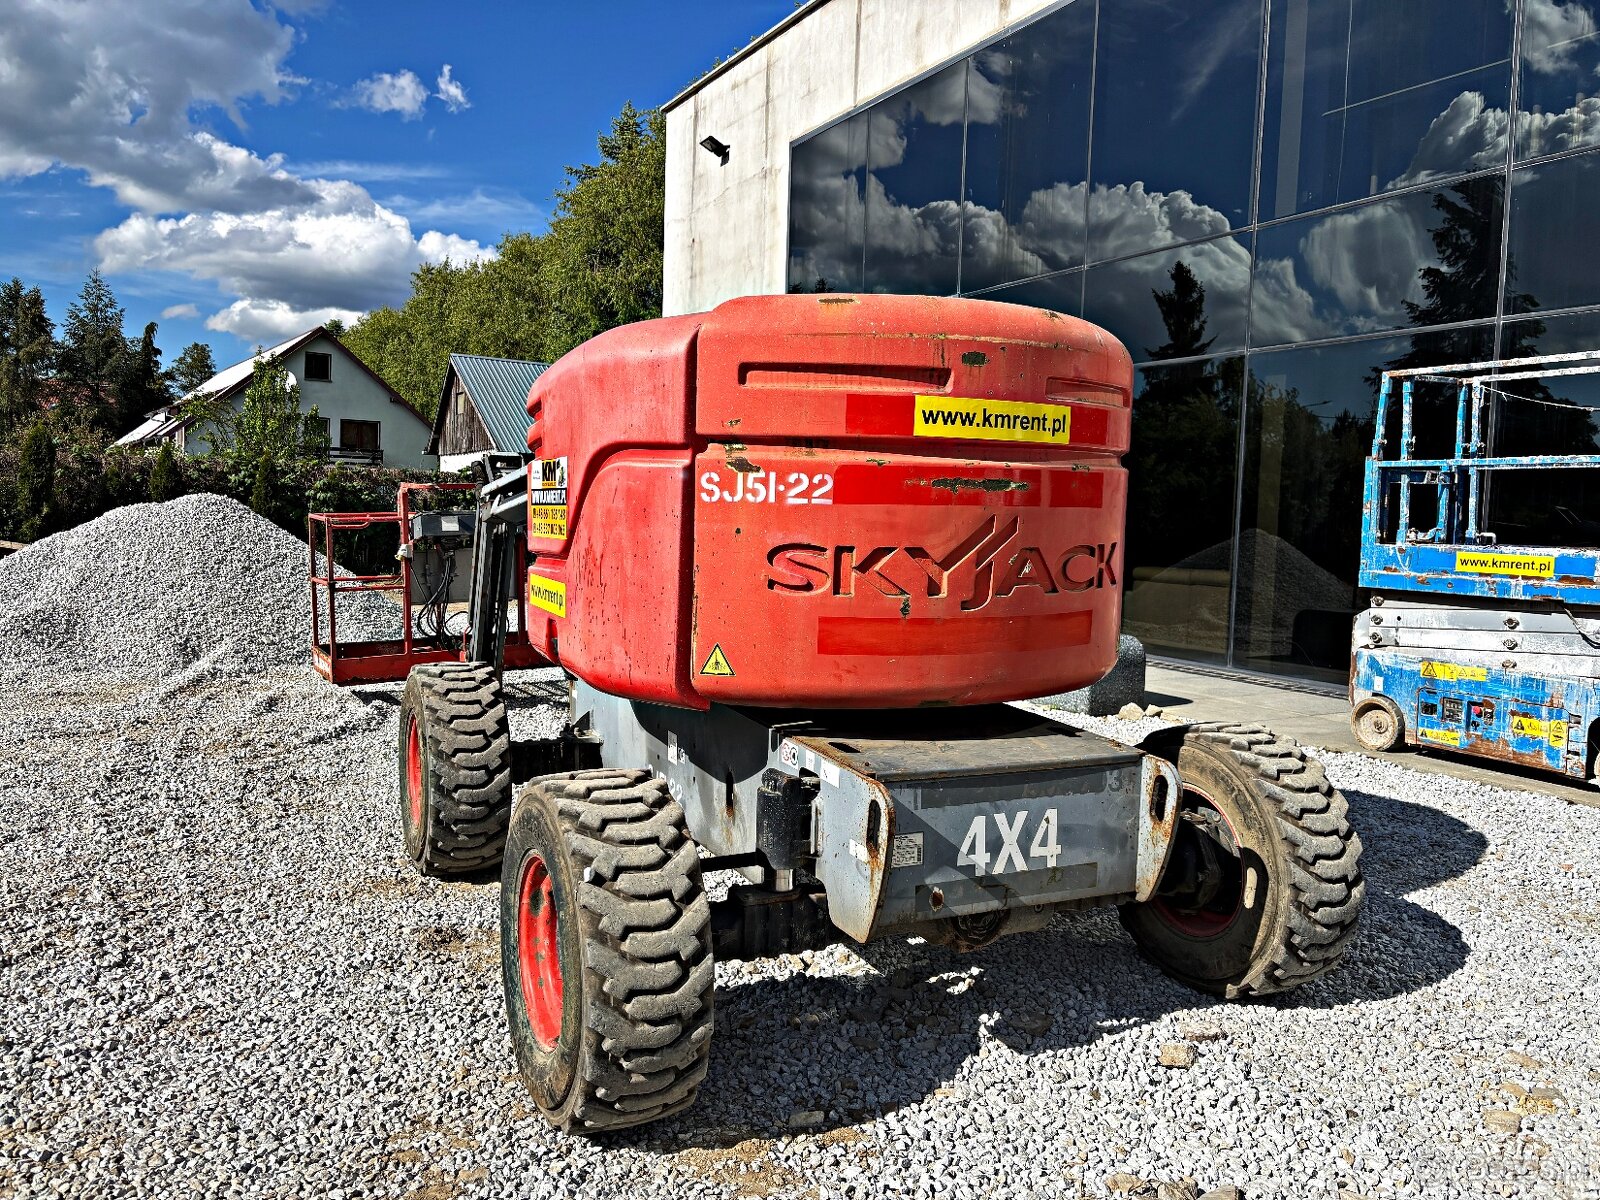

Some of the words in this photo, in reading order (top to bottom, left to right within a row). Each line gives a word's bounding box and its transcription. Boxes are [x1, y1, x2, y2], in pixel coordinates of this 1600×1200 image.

[921, 407, 1068, 434] www.kmrent.pl
[766, 515, 1119, 612] SKYJACK
[1459, 556, 1551, 573] www.kmrent.pl
[957, 808, 1062, 877] 4X4
